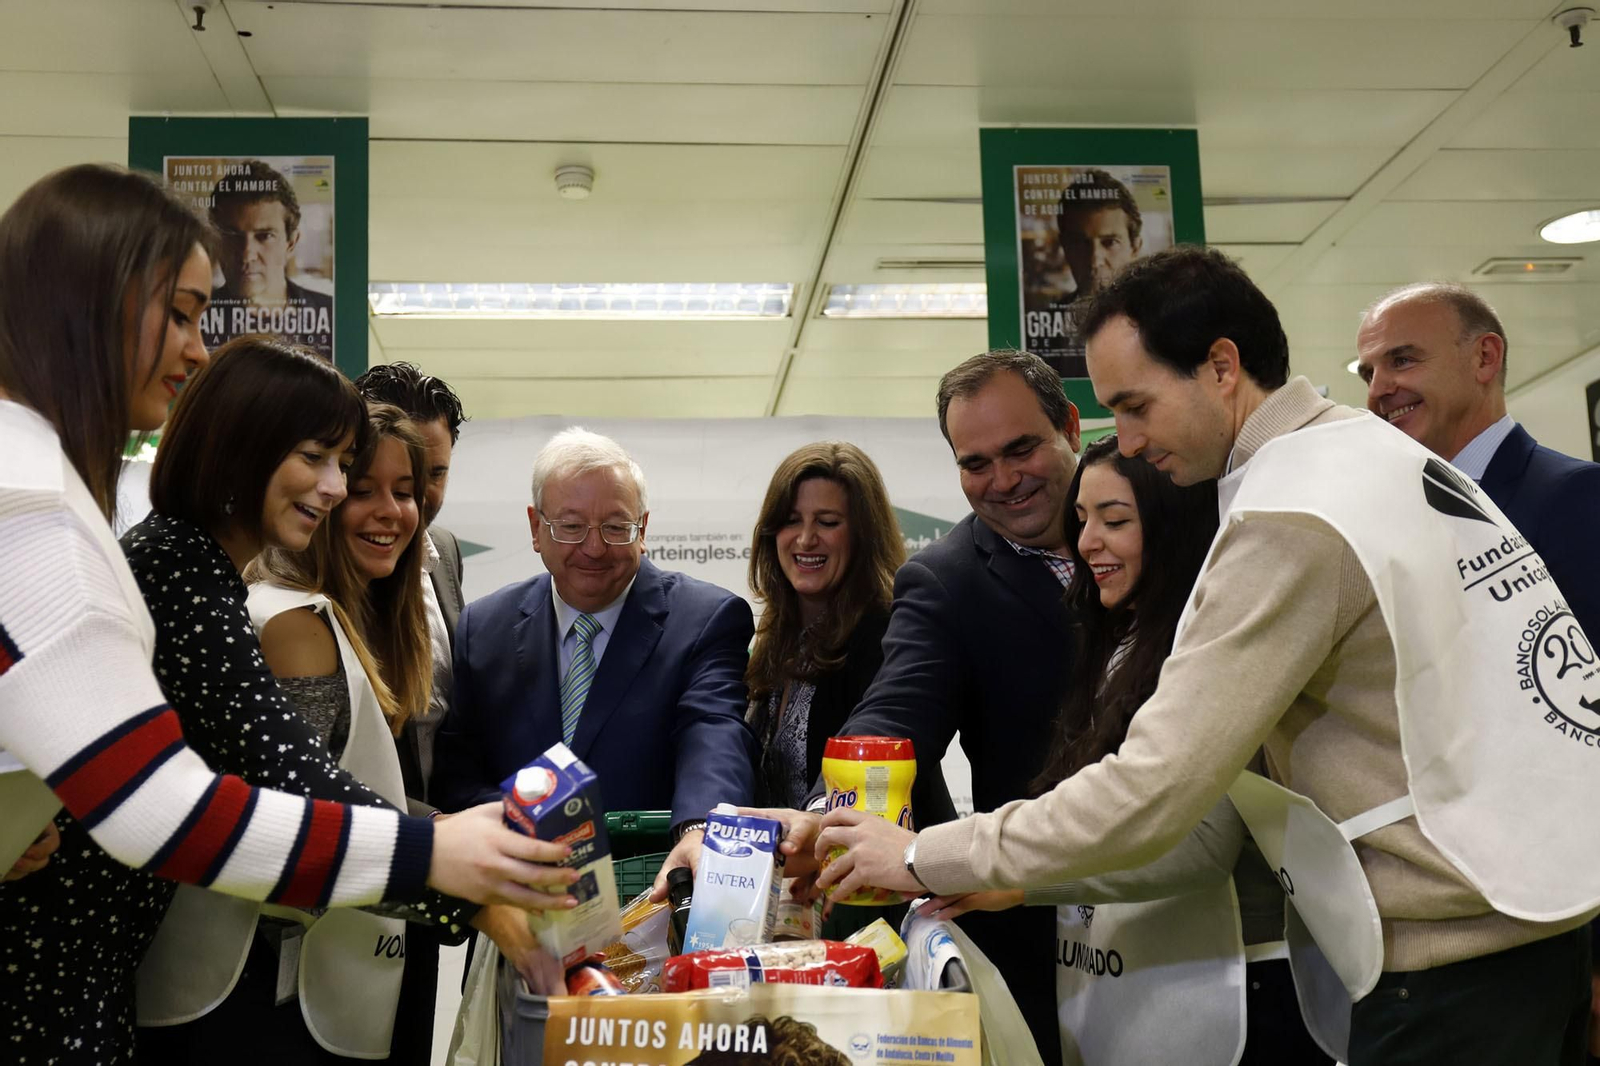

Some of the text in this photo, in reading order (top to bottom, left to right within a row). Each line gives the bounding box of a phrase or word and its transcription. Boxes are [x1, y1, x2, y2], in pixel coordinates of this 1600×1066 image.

[173, 165, 251, 176] JUNTOS AHORA
[1023, 173, 1058, 184] JUNTOS
[218, 181, 231, 192] EL
[235, 180, 278, 192] HAMBRE
[1024, 188, 1120, 200] CONTRA EL HAMBRE
[1024, 204, 1037, 215] DE
[199, 306, 331, 334] AN RECOGIDA
[1516, 605, 1556, 691] BANCOSOL
[1544, 624, 1595, 680] 20
[708, 820, 771, 844] PULEVA
[706, 871, 756, 890] ENTERA
[566, 1016, 769, 1054] JUNTOS AHORA
